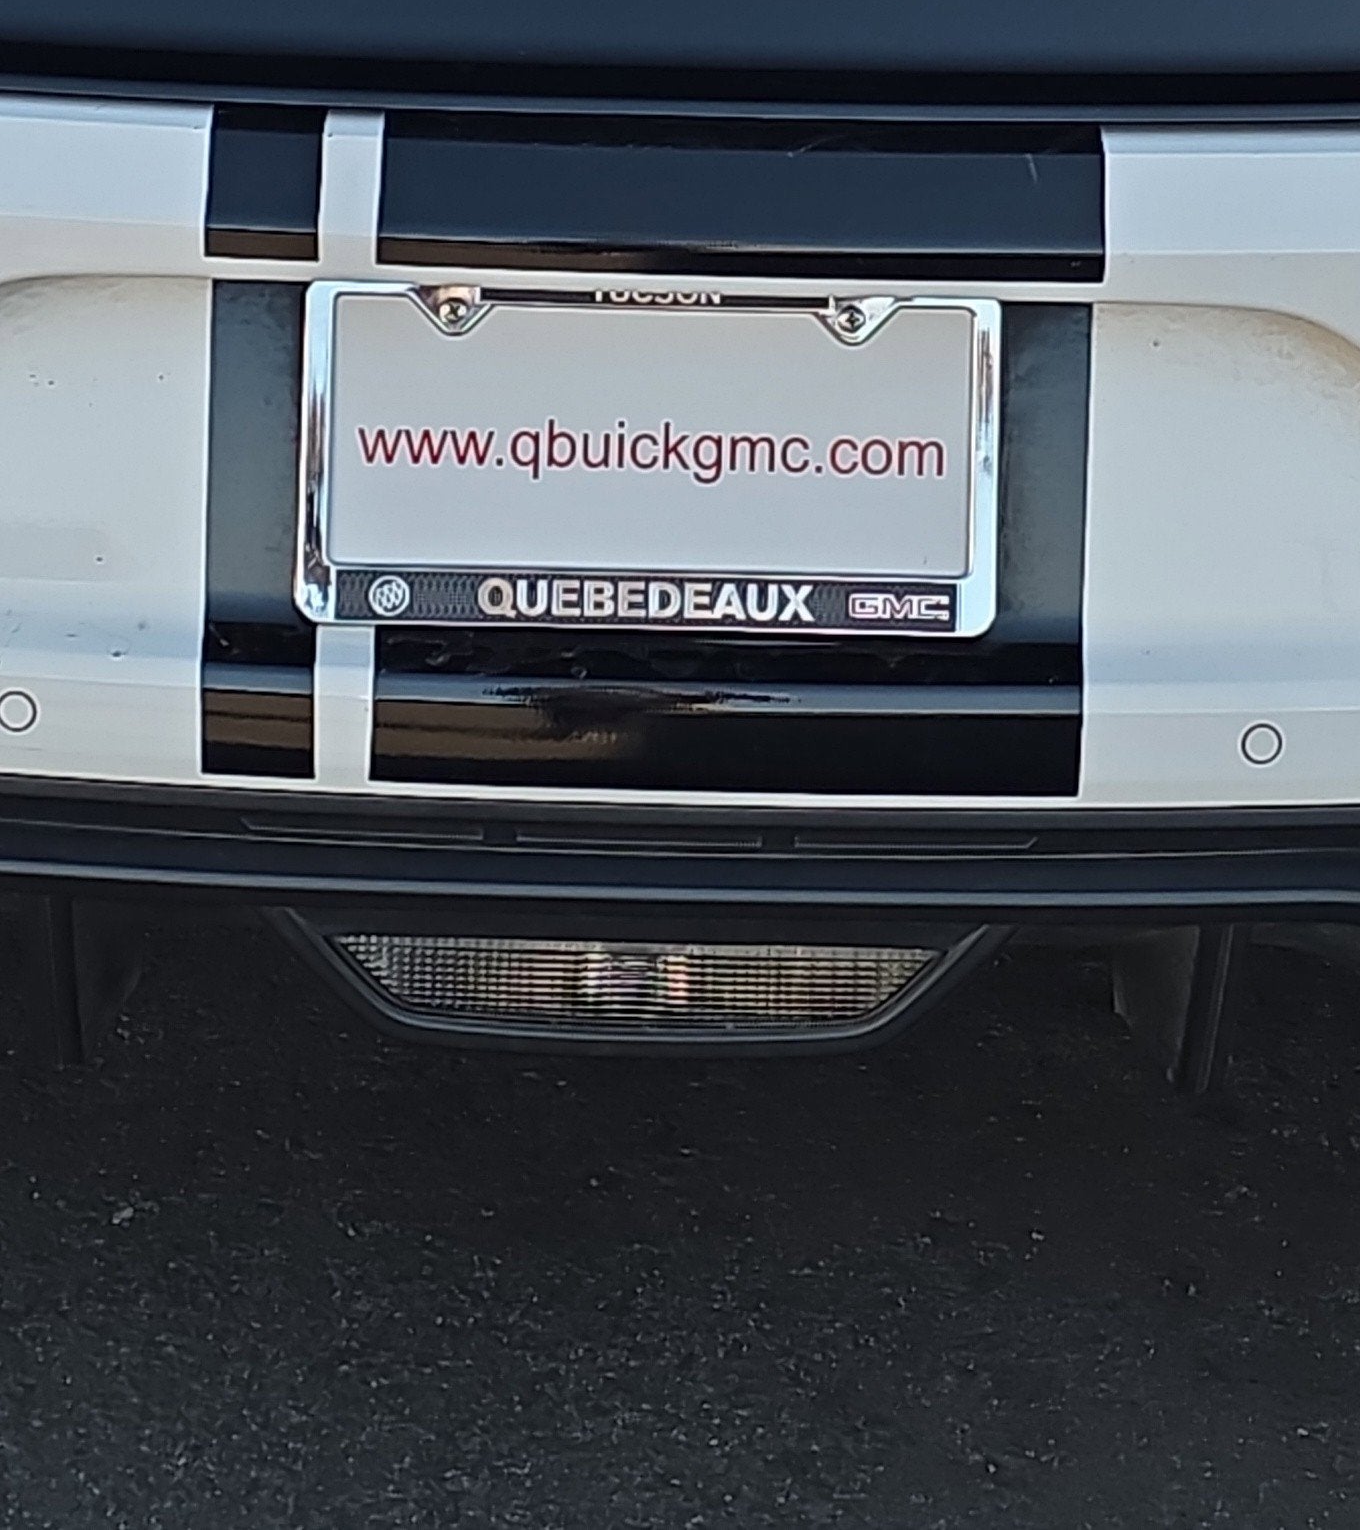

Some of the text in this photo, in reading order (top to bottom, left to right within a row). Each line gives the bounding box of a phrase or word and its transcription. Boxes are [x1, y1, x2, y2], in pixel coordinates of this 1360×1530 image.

[357, 419, 945, 483] www.qbuickgmc.com
[477, 577, 950, 622] QUEBEDEAUX GMC
